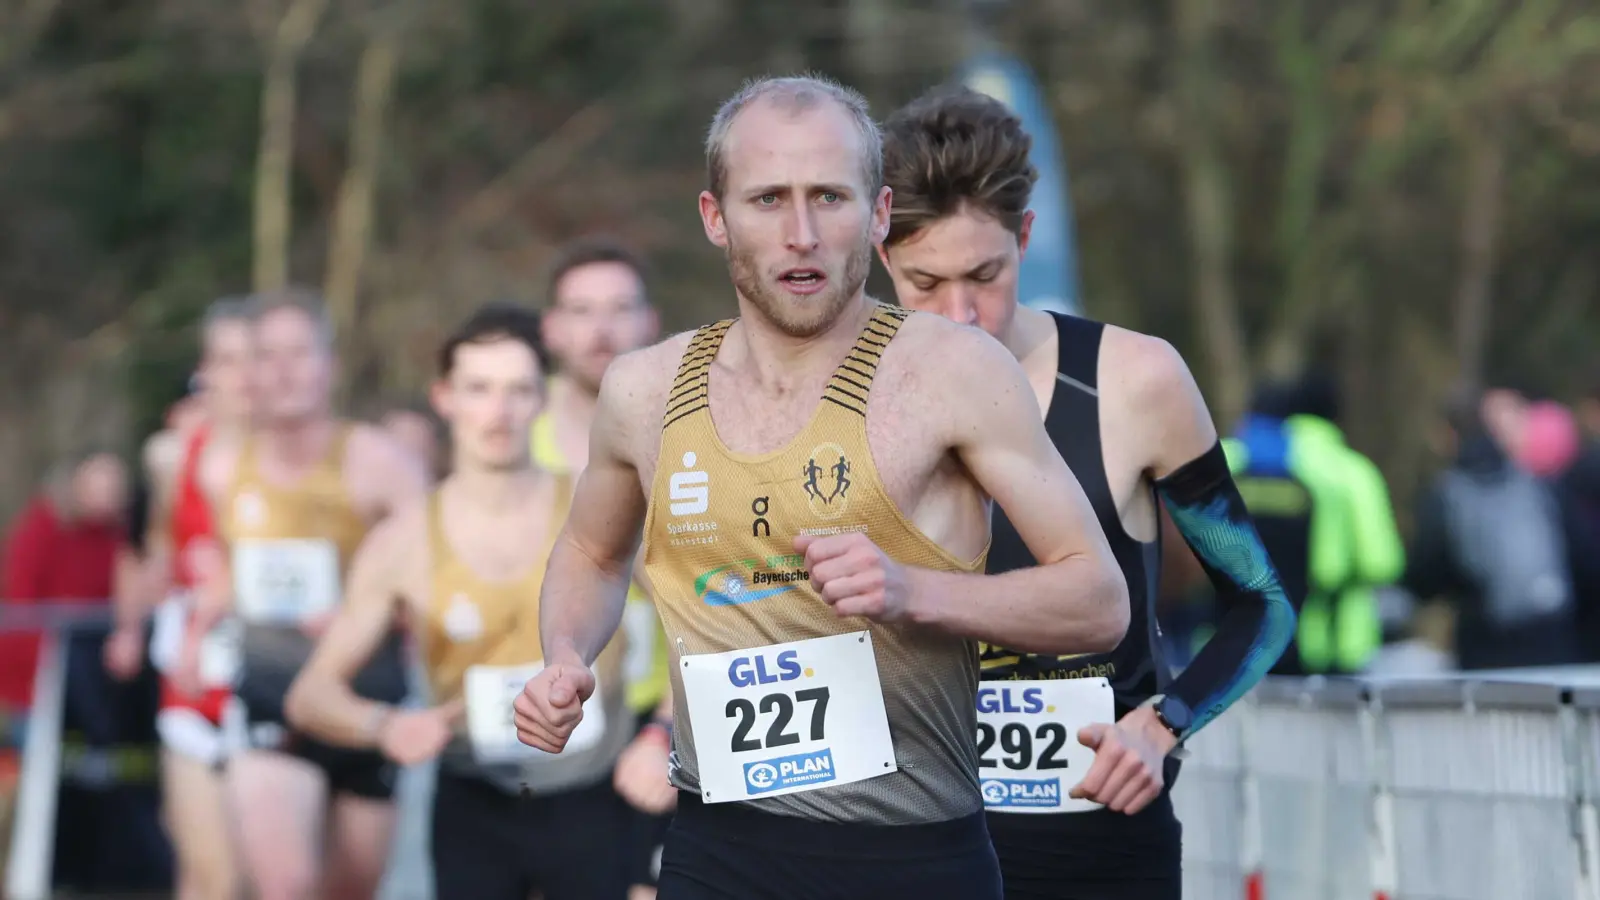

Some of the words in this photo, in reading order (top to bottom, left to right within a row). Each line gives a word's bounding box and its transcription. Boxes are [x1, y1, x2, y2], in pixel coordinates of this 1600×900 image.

[667, 521, 718, 535] Sparkasse
[753, 569, 810, 585] Bayerische
[725, 686, 830, 753] 227
[976, 721, 1069, 771] 292
[780, 755, 831, 777] PLAN
[782, 771, 832, 785] INTERNATIONAL
[1010, 783, 1057, 798] PLAN
